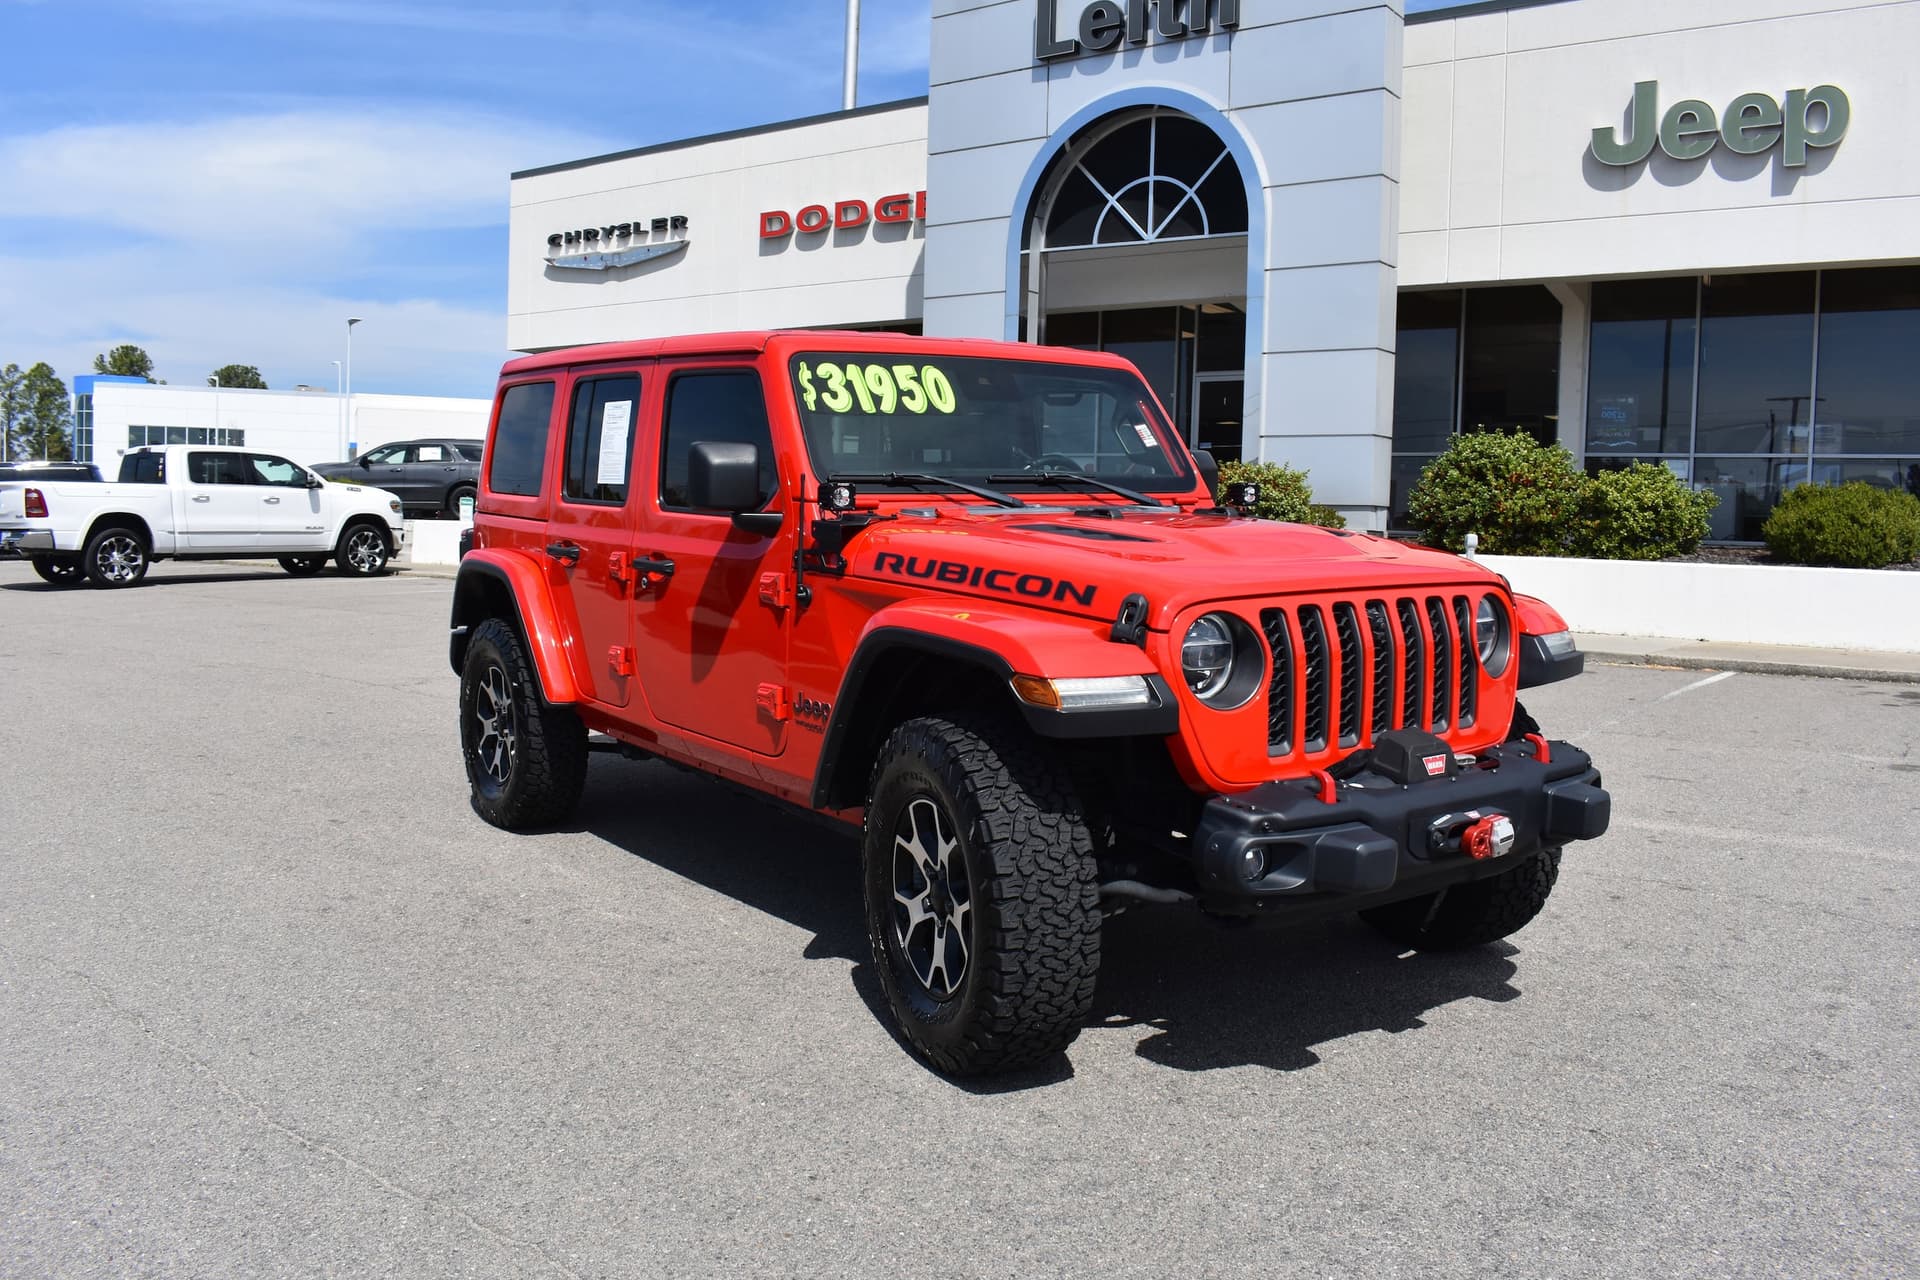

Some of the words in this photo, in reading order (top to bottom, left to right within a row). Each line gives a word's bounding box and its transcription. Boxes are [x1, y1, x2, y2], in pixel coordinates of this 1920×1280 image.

[1591, 79, 1850, 167] Jeep
[547, 215, 689, 247] CHRYSLER
[799, 361, 956, 414] $31950
[873, 551, 1098, 606] RUBICON
[793, 690, 832, 723] Jeep
